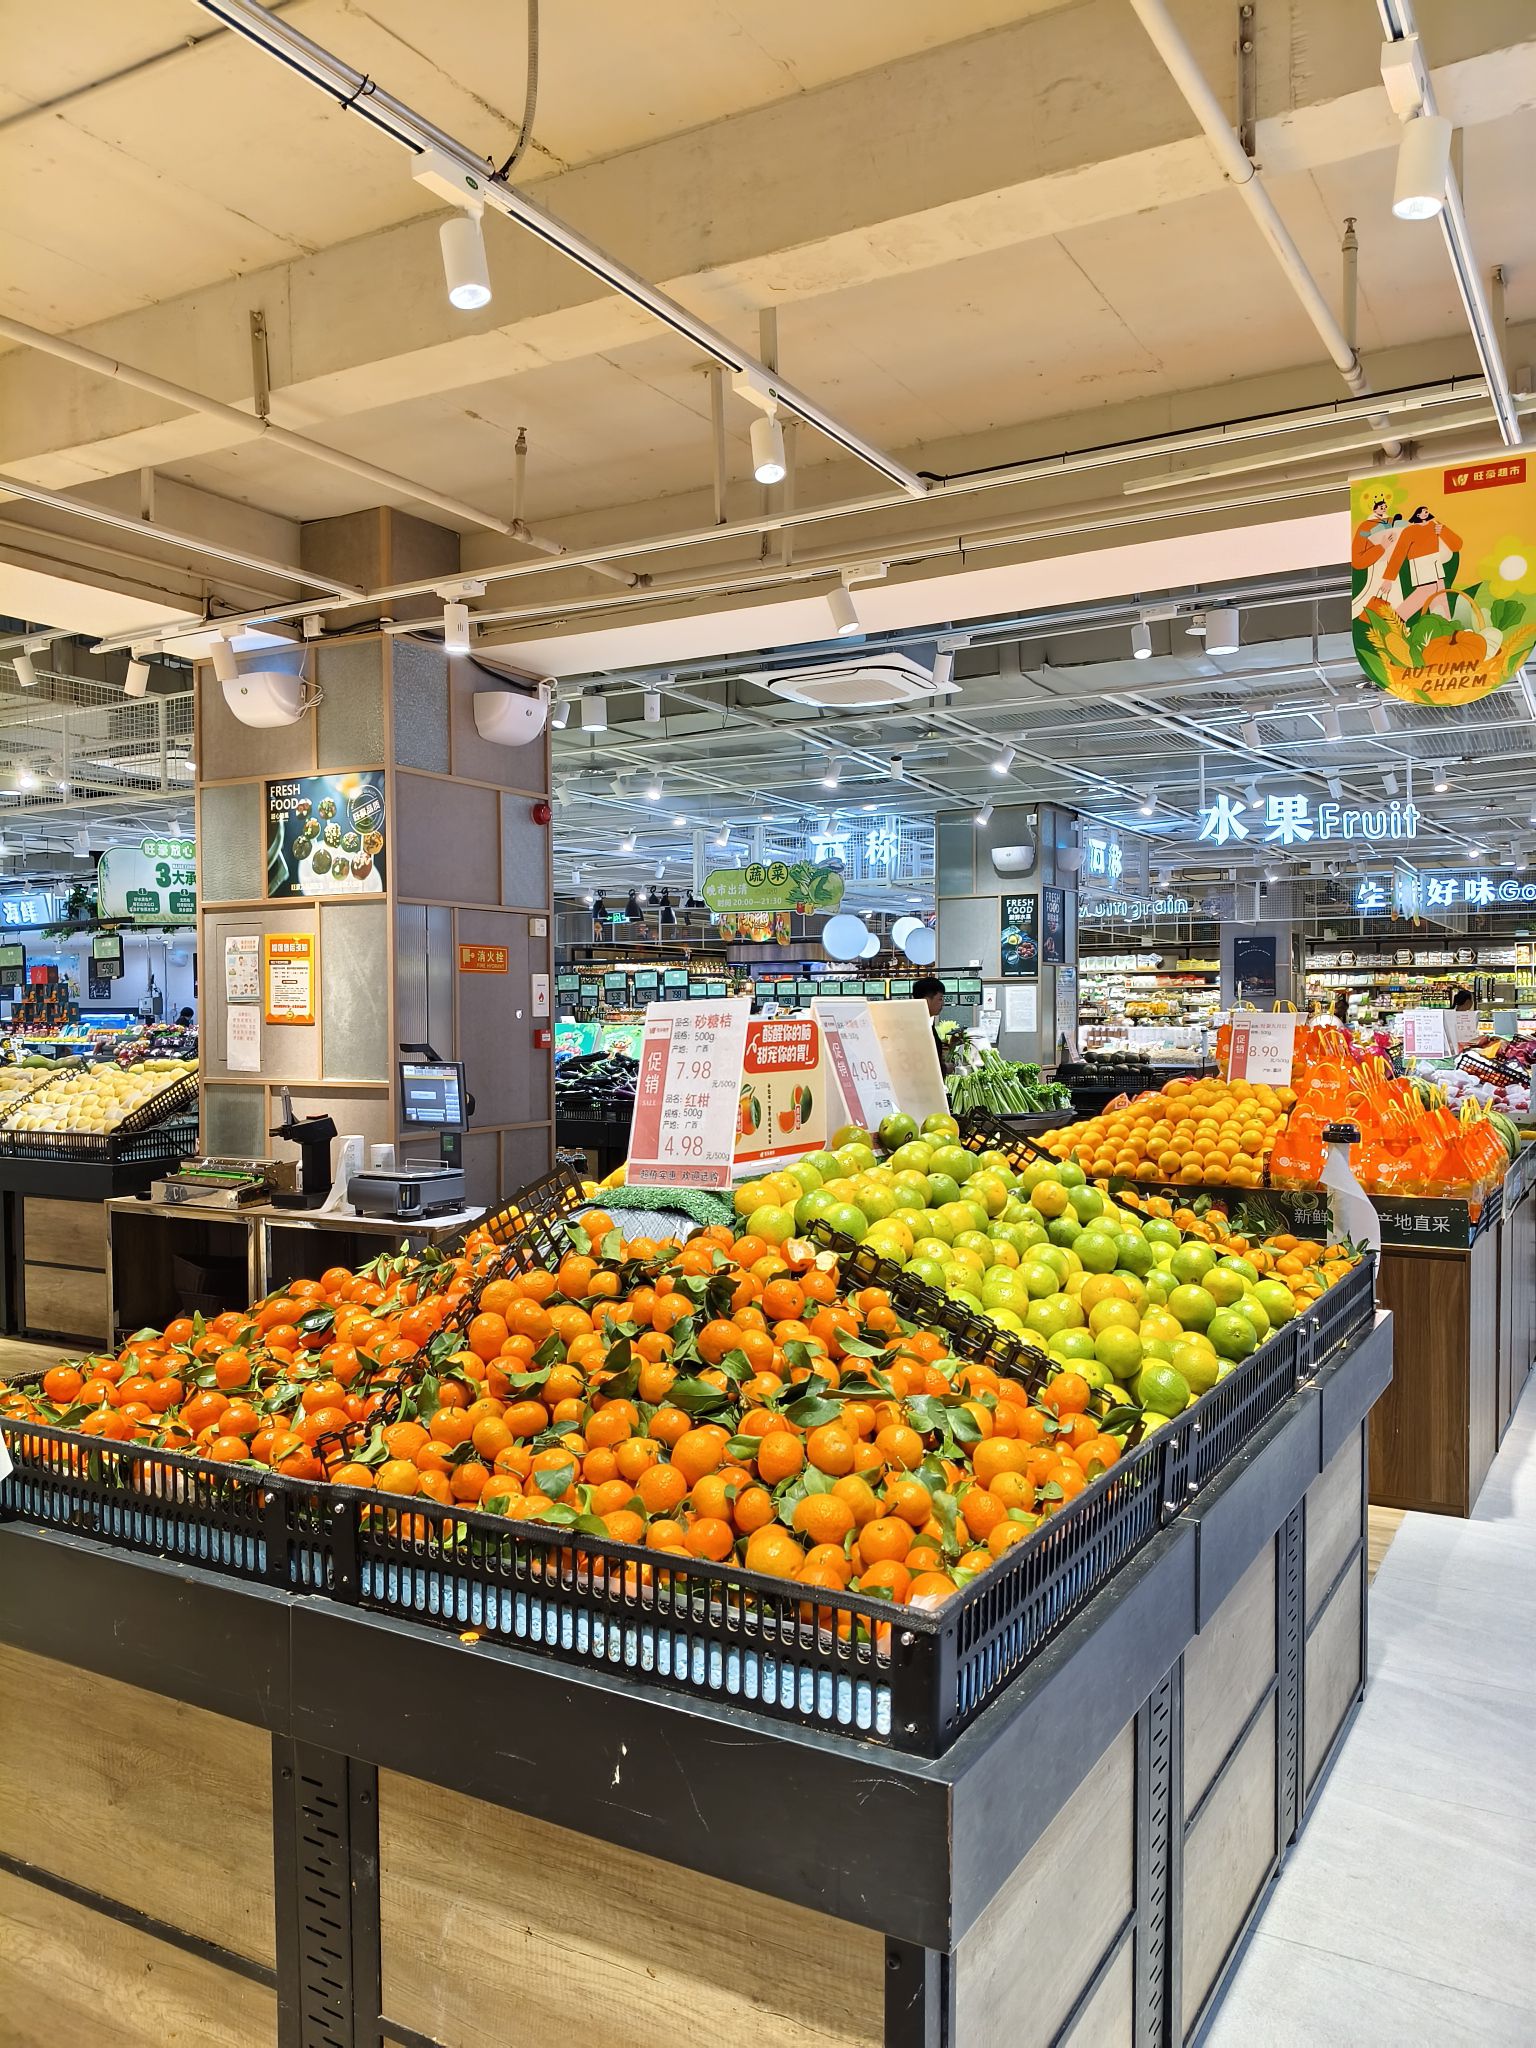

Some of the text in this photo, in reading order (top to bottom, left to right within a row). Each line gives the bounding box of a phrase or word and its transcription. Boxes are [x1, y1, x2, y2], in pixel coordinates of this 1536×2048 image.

[1473, 466, 1521, 481] 旺豪超市
[1402, 660, 1479, 681] AUTUMN
[1421, 673, 1487, 692] CHARM
[270, 784, 301, 798] FRESH
[270, 798, 298, 811] FOOD
[1197, 794, 1420, 846] 水果 Fruit
[748, 865, 785, 883] 蔬菜
[1006, 899, 1034, 907] FRESH
[1045, 891, 1060, 903] FRESH
[3, 901, 39, 924] 海鲜
[1008, 906, 1033, 914] FOOD
[1046, 902, 1060, 913] FOOD
[477, 950, 504, 963] 消火栓
[694, 1013, 732, 1029] 砂糖桔
[694, 1031, 715, 1043] 500g
[1236, 1034, 1246, 1054] 促销
[695, 1045, 709, 1053] 广西
[1249, 1045, 1279, 1057] 8.90
[832, 1042, 849, 1078] 促销
[645, 1052, 662, 1094] 促销
[677, 1061, 712, 1079] 7.98
[852, 1061, 877, 1081] 4.98
[712, 1080, 736, 1088] 元/500g
[684, 1093, 711, 1108] 红柑
[683, 1108, 703, 1119] 500g
[684, 1121, 698, 1129] 广西
[665, 1136, 703, 1156] 4.98
[706, 1152, 730, 1161] 元/500g
[1294, 1208, 1329, 1226] 新鲜
[1377, 1212, 1451, 1233] 产地直采
